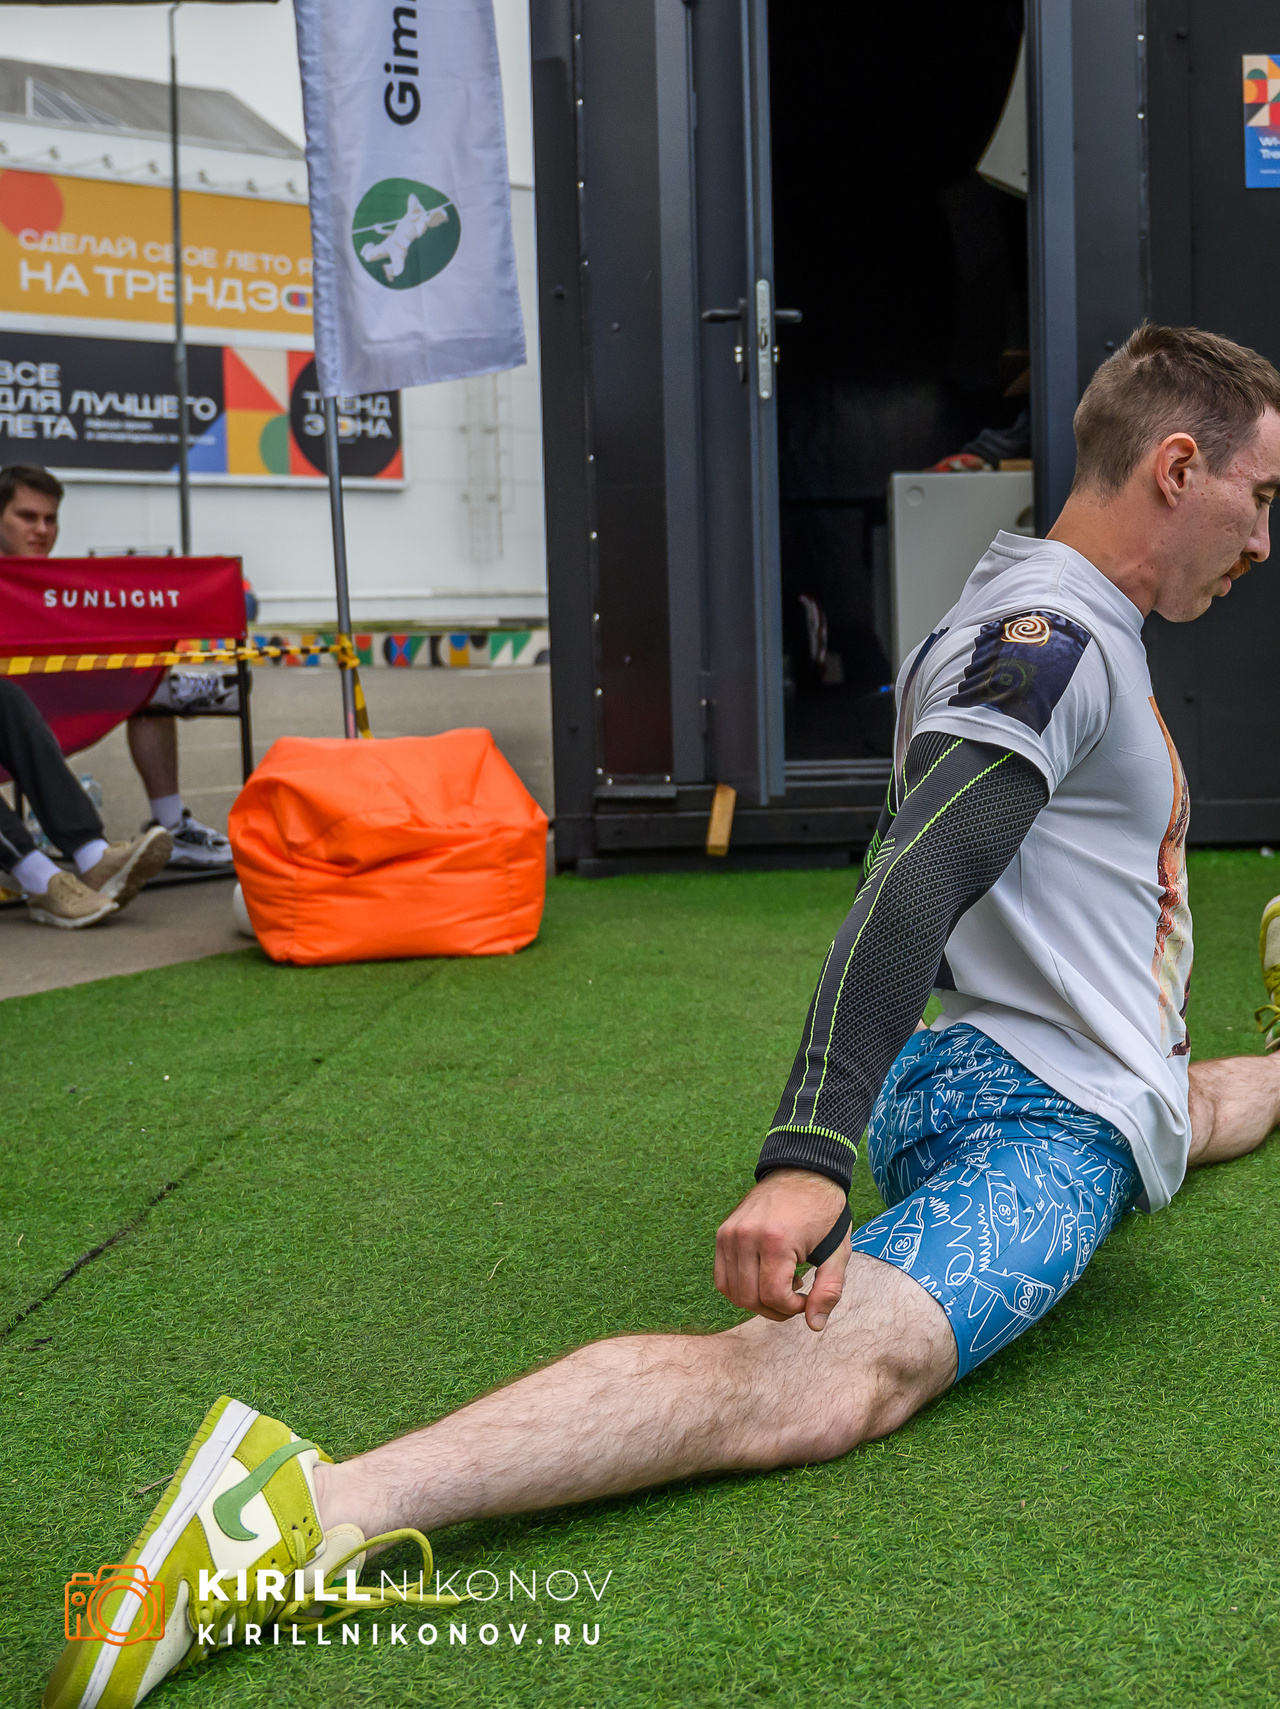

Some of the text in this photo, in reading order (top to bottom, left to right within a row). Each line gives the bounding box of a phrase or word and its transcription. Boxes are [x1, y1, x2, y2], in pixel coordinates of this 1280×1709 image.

[384, 0, 421, 126] Gim
[19, 228, 137, 260] СДЕЛАЙ
[225, 249, 292, 276] ЛЕТО
[19, 259, 89, 297] НА
[93, 265, 313, 316] ТРЕНДЗО
[303, 391, 392, 418] ТЕНД
[44, 589, 180, 608] SUNLIGHT
